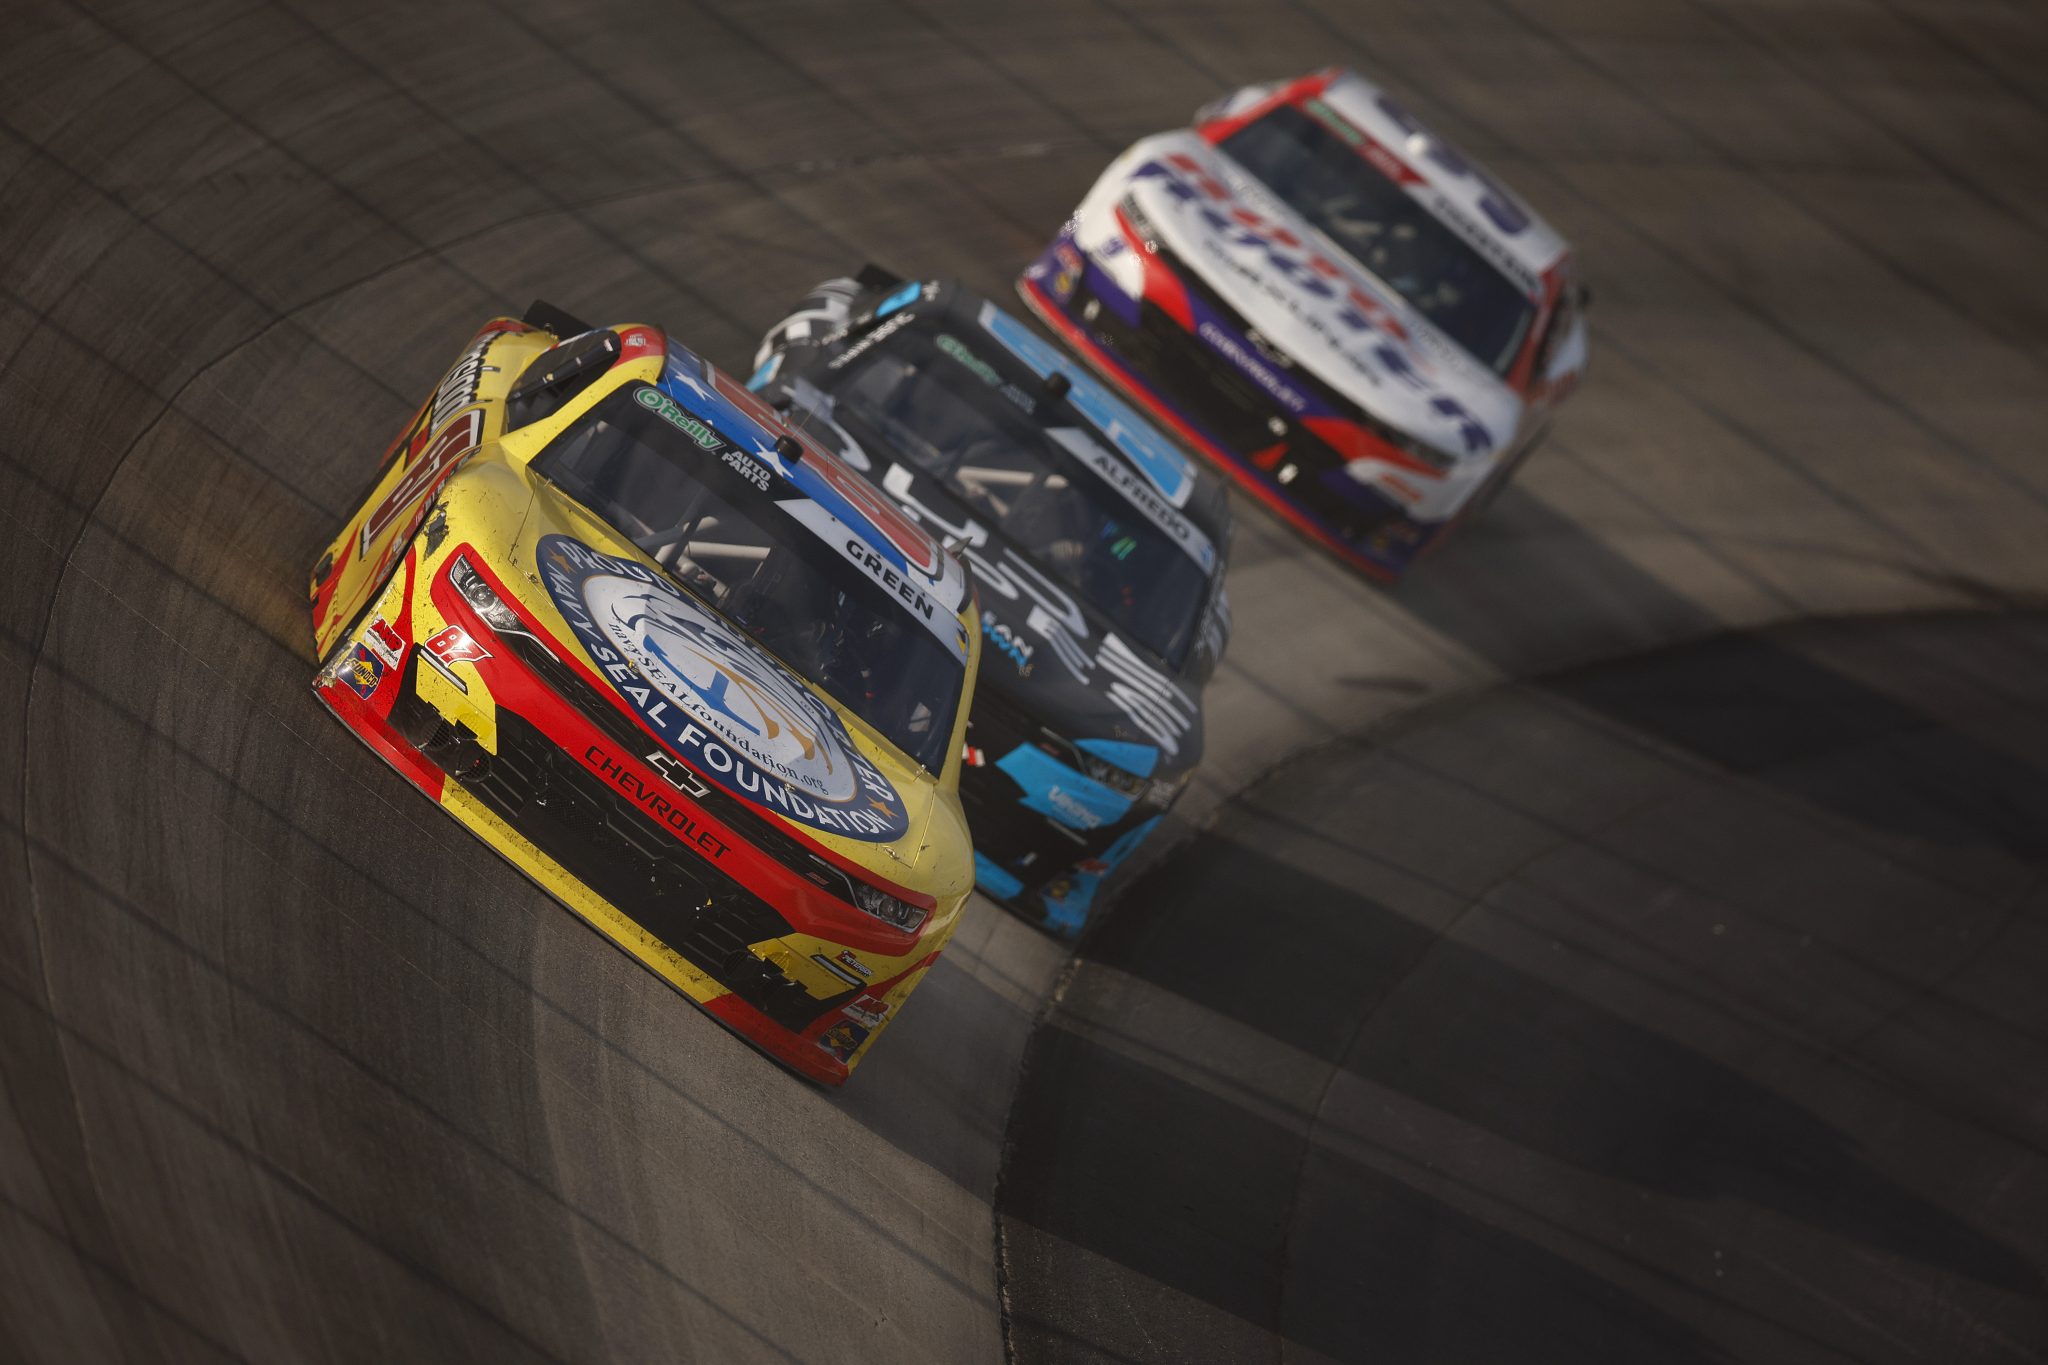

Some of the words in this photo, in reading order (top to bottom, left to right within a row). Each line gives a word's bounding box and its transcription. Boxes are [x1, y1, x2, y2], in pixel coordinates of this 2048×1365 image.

[721, 452, 770, 492] PARTS
[731, 450, 772, 481] AUTO
[1093, 456, 1190, 540] ALFREDO
[556, 540, 681, 597] PROUD
[846, 539, 934, 621] GREEN
[350, 658, 379, 687] SUNOCO
[425, 624, 494, 667] 87
[546, 562, 603, 642] NAVY
[590, 643, 671, 728] SEAL
[677, 723, 894, 834] FOUNDATION
[608, 622, 829, 796] navySEALfoundation.org
[583, 745, 731, 859] CHEVROLET
